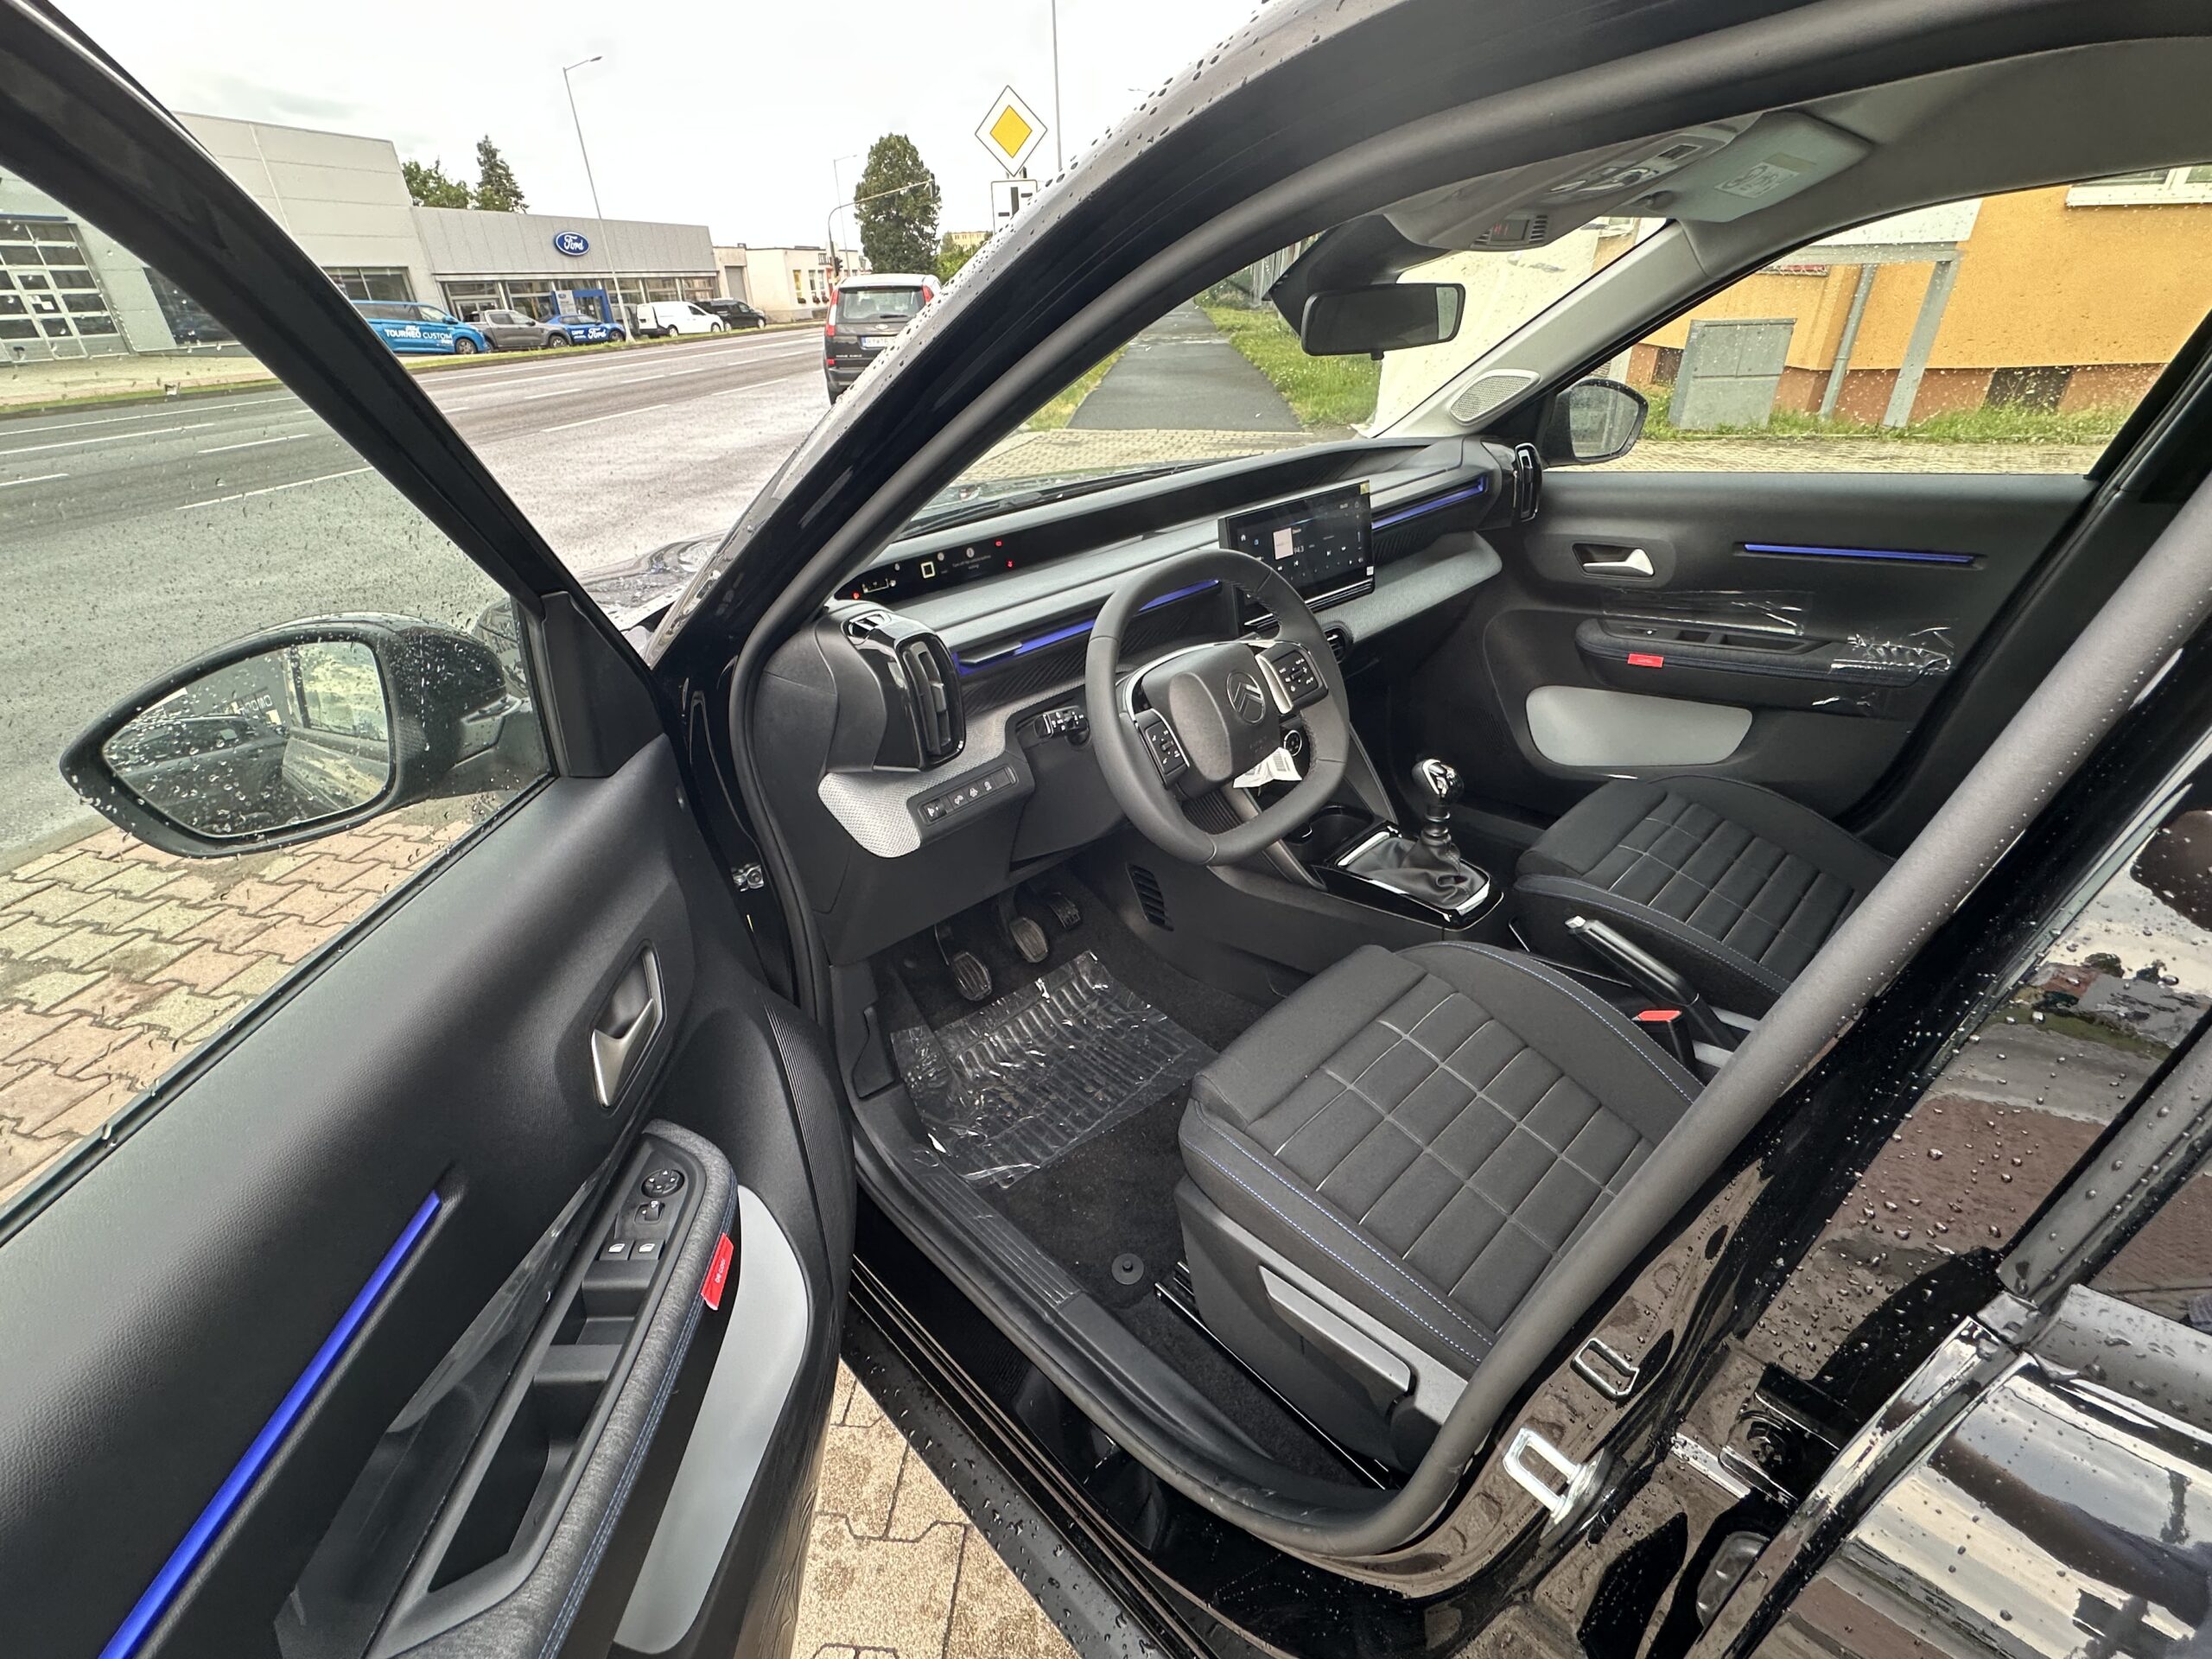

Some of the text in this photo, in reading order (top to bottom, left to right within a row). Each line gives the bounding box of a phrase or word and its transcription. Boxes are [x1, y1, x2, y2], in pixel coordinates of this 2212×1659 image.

[563, 234, 584, 251] Ford
[385, 328, 422, 339] TOURNEO
[588, 327, 607, 340] Ford
